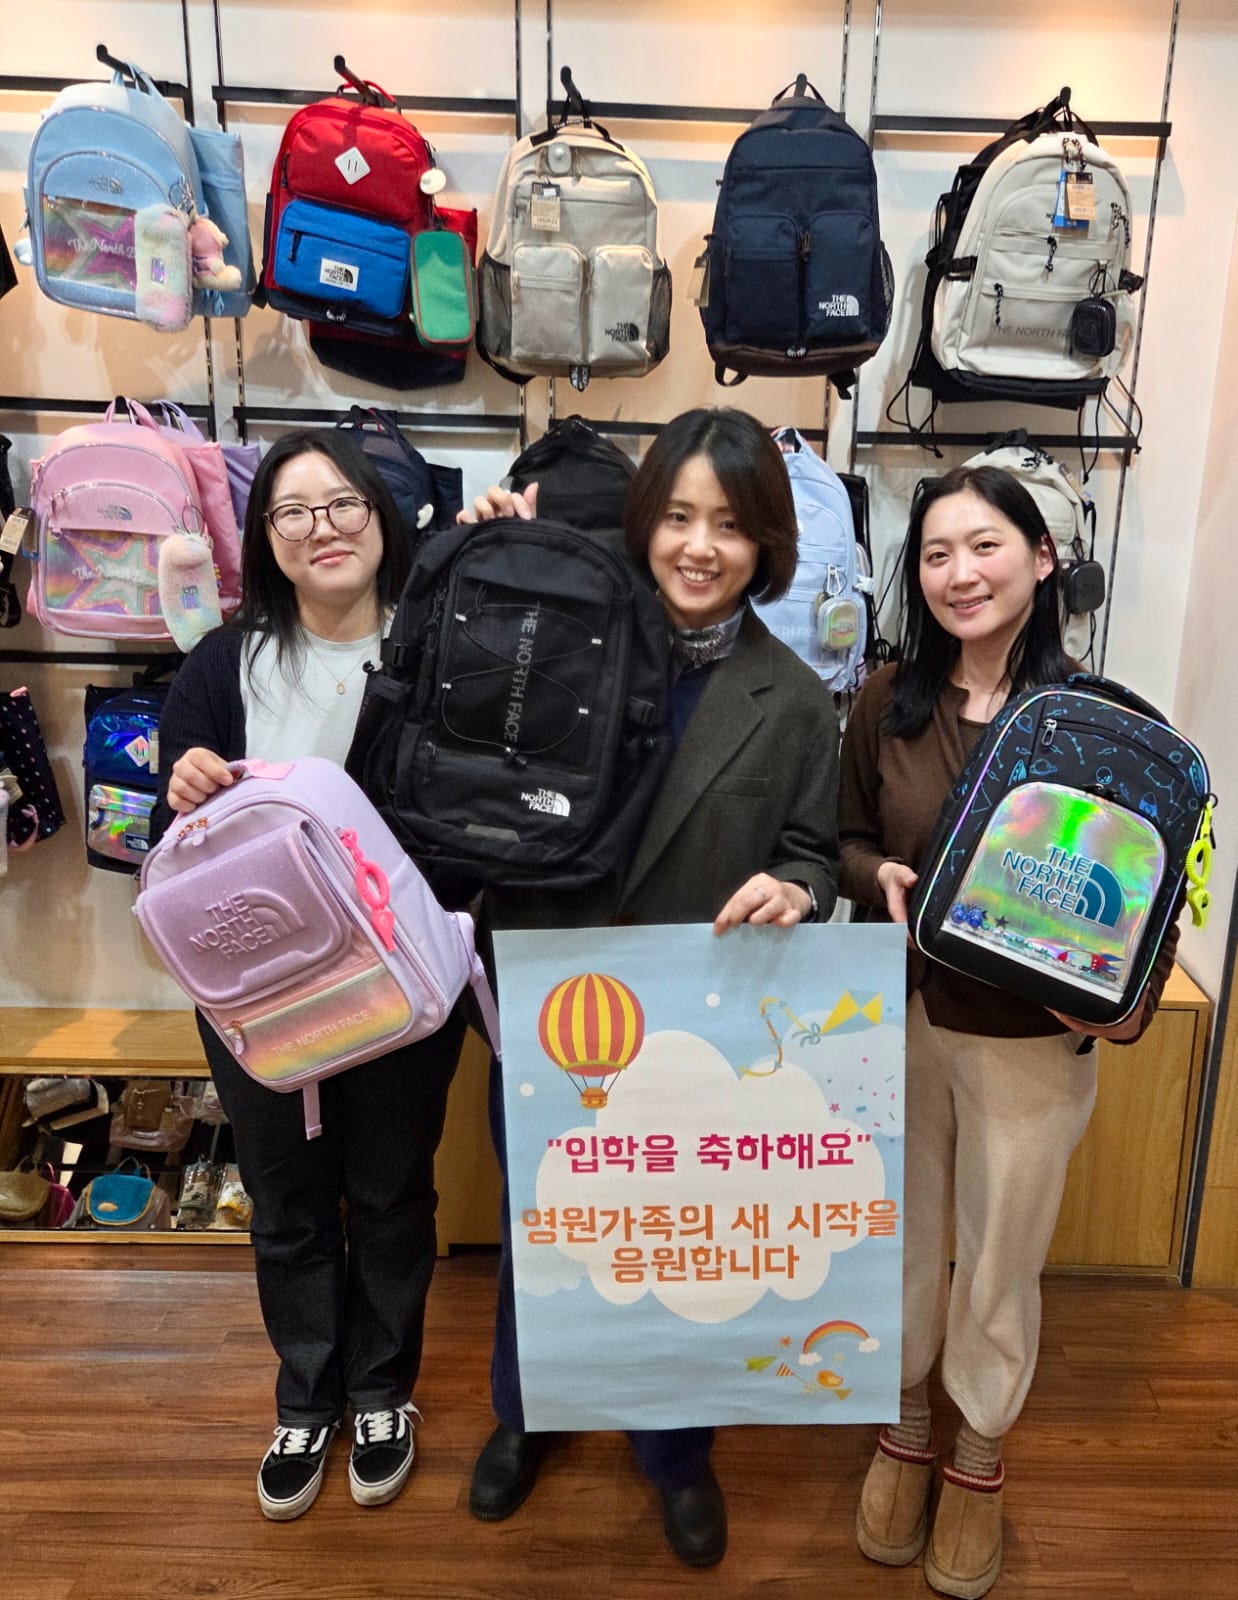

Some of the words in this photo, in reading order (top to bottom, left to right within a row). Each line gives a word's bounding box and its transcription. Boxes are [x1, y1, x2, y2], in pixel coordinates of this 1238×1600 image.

[818, 301, 847, 310] NORTH
[826, 309, 847, 317] FACE
[832, 294, 847, 302] THE
[604, 328, 630, 337] NORTH
[1015, 326, 1056, 338] NORTH
[503, 702, 523, 743] FACE
[520, 791, 554, 807] NORTH
[528, 801, 554, 813] FACE
[537, 788, 556, 800] THE
[1002, 849, 1084, 895] NORTH
[1047, 845, 1091, 876] THE
[205, 893, 249, 922] THE
[1017, 876, 1075, 912] FACE
[189, 909, 260, 952] NORTH
[219, 927, 273, 960] FACE
[271, 1042, 295, 1056] THE
[296, 1023, 339, 1048] NORTH
[339, 1009, 370, 1029] FACE
[547, 1134, 679, 1173] "입학을
[696, 1133, 873, 1170] 축하해요"
[521, 1204, 714, 1245] 영원가족의
[731, 1204, 770, 1239] 새
[787, 1199, 901, 1238] 시작을
[610, 1245, 800, 1283] 응원합니다
